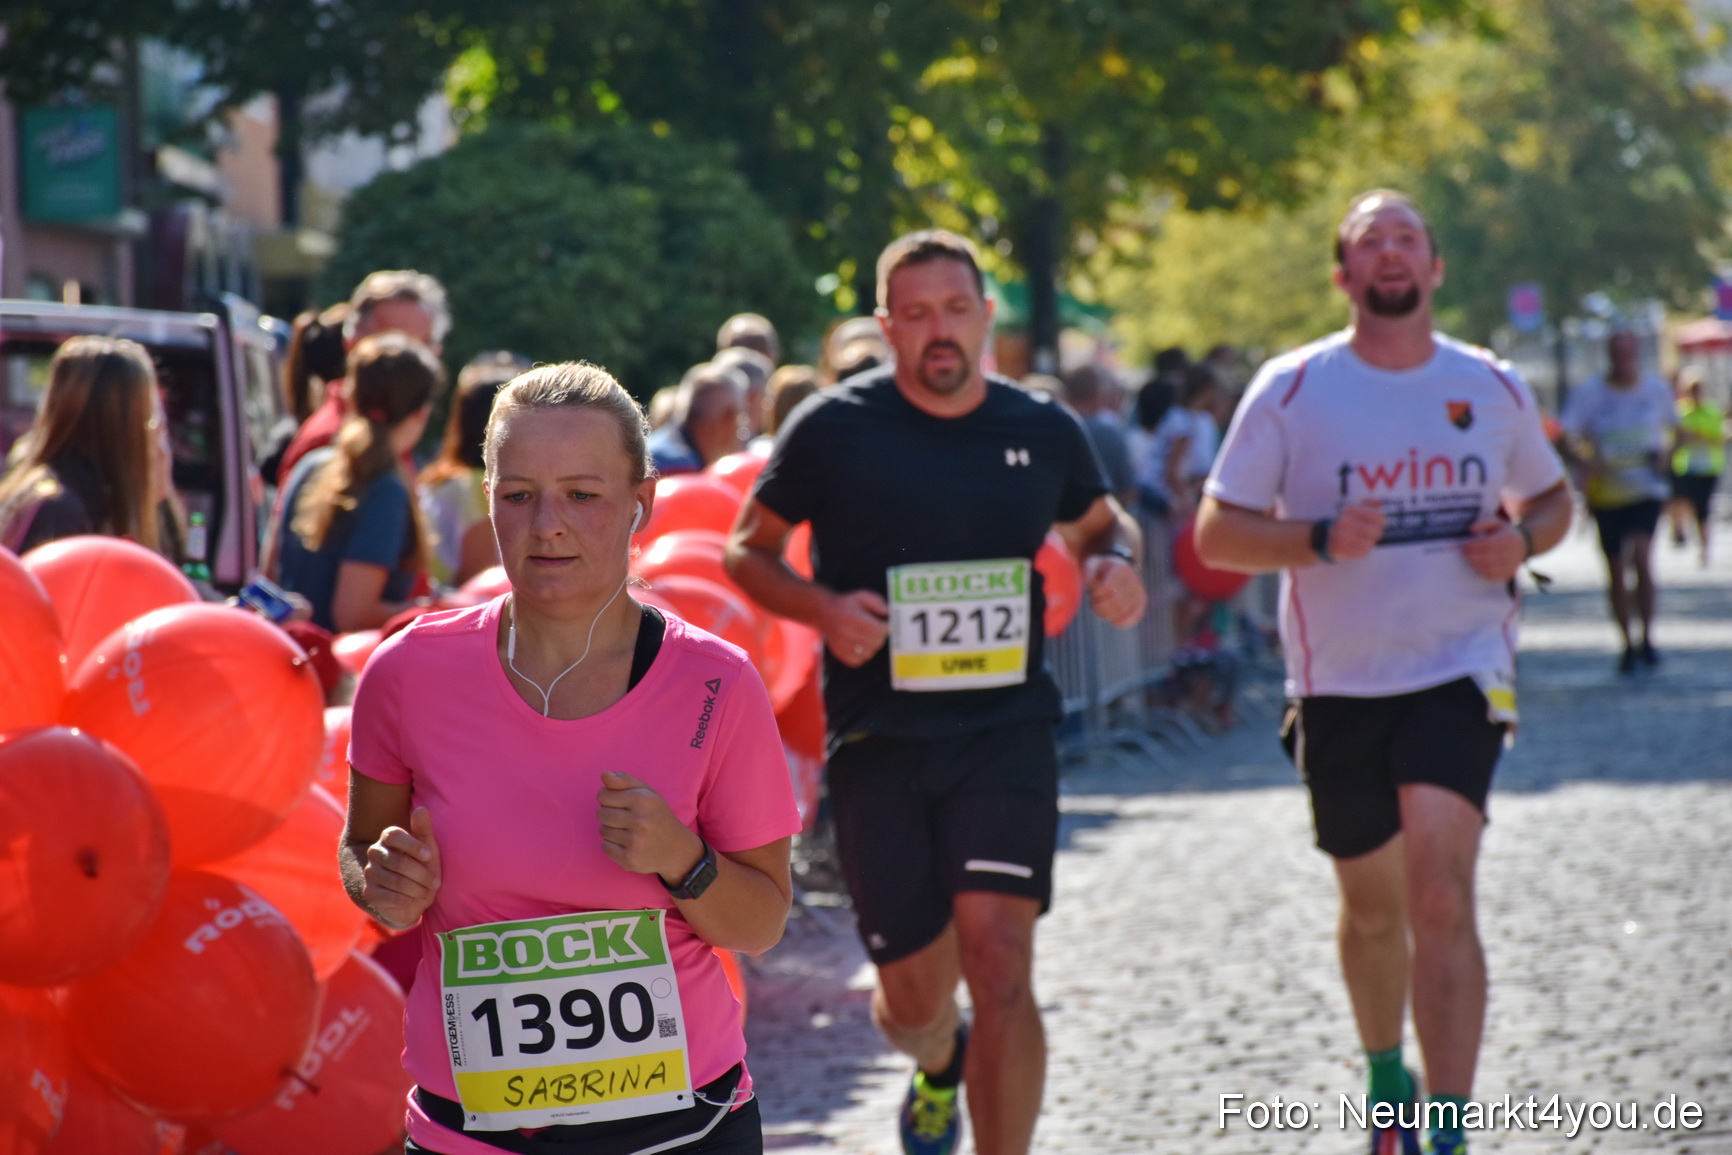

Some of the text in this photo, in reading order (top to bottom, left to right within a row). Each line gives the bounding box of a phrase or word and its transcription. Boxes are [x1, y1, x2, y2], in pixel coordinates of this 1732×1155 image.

[1338, 448, 1487, 496] twinn
[904, 569, 1008, 596] BOCK
[910, 604, 1013, 646] 1212
[940, 655, 987, 672] UWE
[689, 695, 716, 749] Reebok
[459, 920, 644, 976] BOCK
[470, 981, 655, 1058] 1390
[503, 1060, 667, 1107] SABRINA
